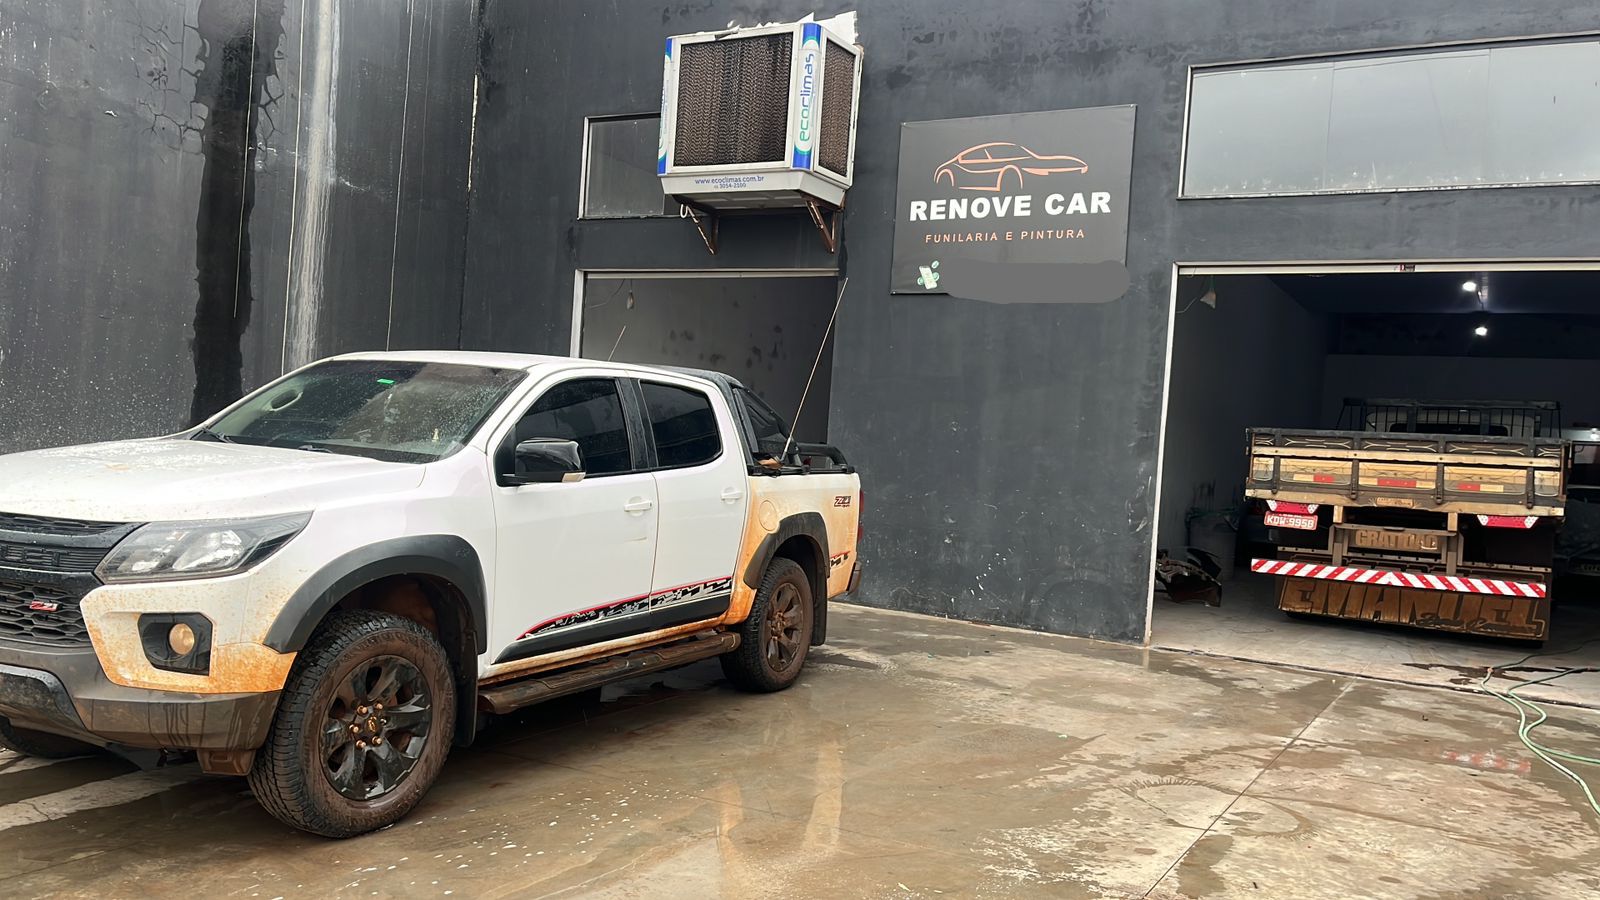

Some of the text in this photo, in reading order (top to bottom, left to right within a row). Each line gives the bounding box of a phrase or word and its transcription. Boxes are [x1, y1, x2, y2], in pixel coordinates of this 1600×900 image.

[694, 175, 765, 184] www.ecoclimas.com.br
[909, 191, 1111, 221] RENOVE CAR
[925, 229, 1085, 243] FUNILARIA E PINTURA
